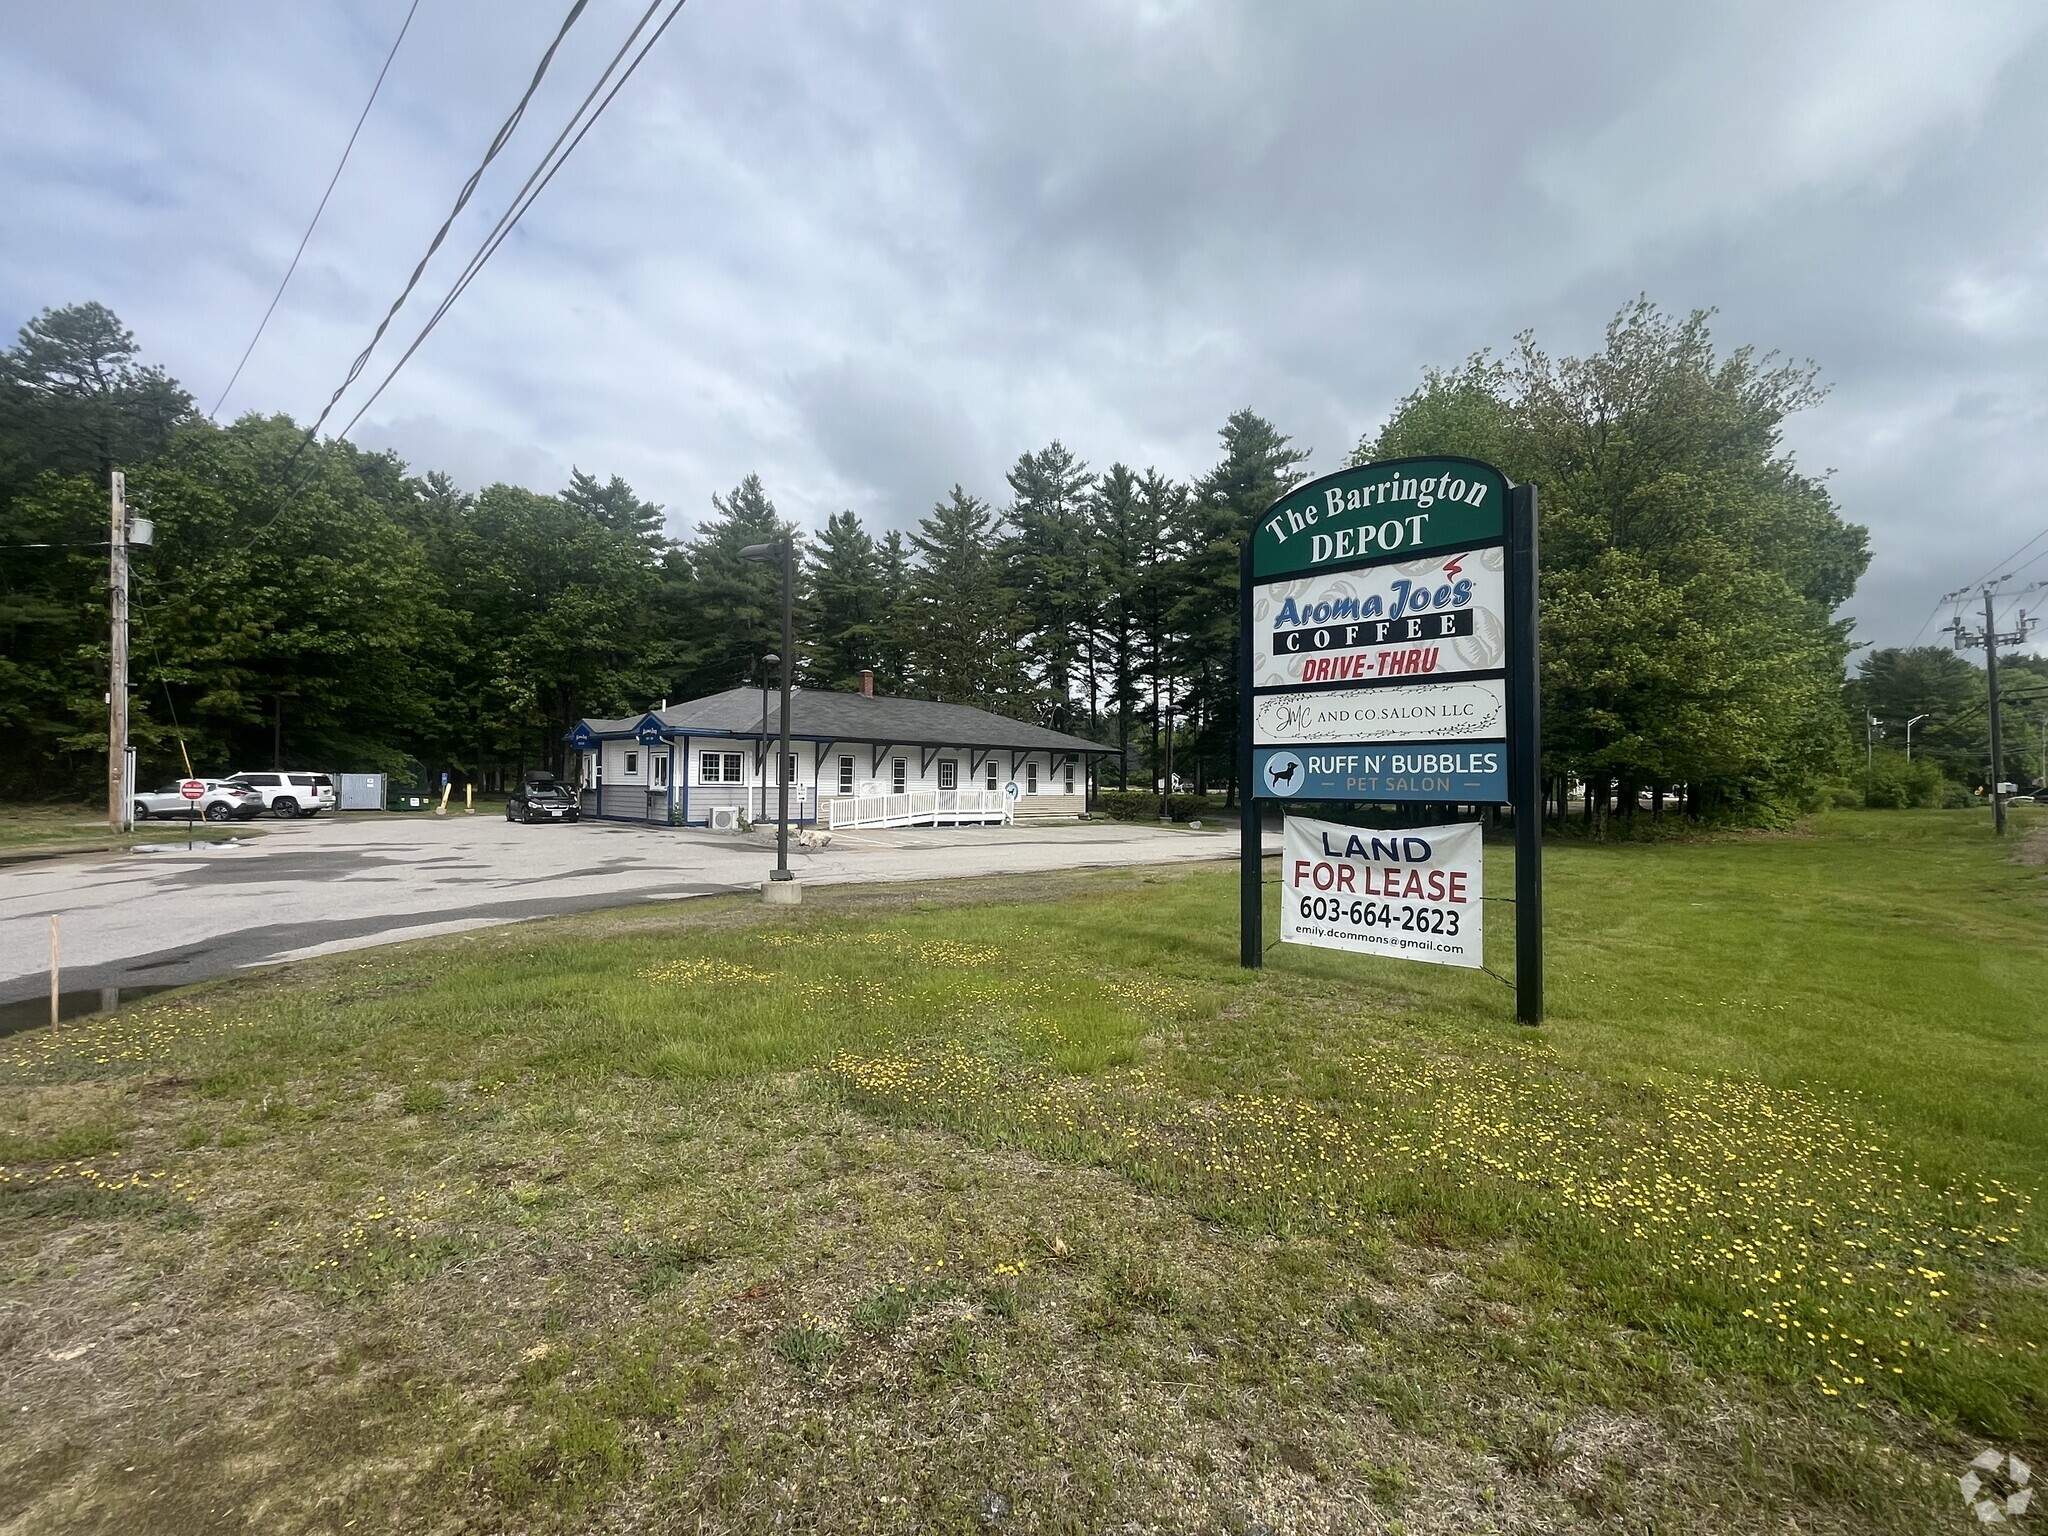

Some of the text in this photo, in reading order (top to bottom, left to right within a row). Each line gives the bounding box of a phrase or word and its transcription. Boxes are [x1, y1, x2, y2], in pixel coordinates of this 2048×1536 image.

[1265, 471, 1488, 544] The Barrington
[1310, 513, 1429, 563] DEPOT
[1273, 595, 1383, 629] Aroma
[1286, 614, 1457, 651] COFFEE
[1302, 647, 1439, 682] DRIVE-THRU
[1318, 710, 1350, 723] AND
[1442, 703, 1474, 717] LLC
[1308, 753, 1498, 774] RUFF N' BUBBLES
[1347, 777, 1450, 791] PET SALON
[1322, 831, 1432, 863] LAND
[1294, 860, 1467, 903] FOR LEASE
[1300, 896, 1459, 936] 603-664-2623
[1296, 924, 1464, 954] emily.dcommons@gmail.com
